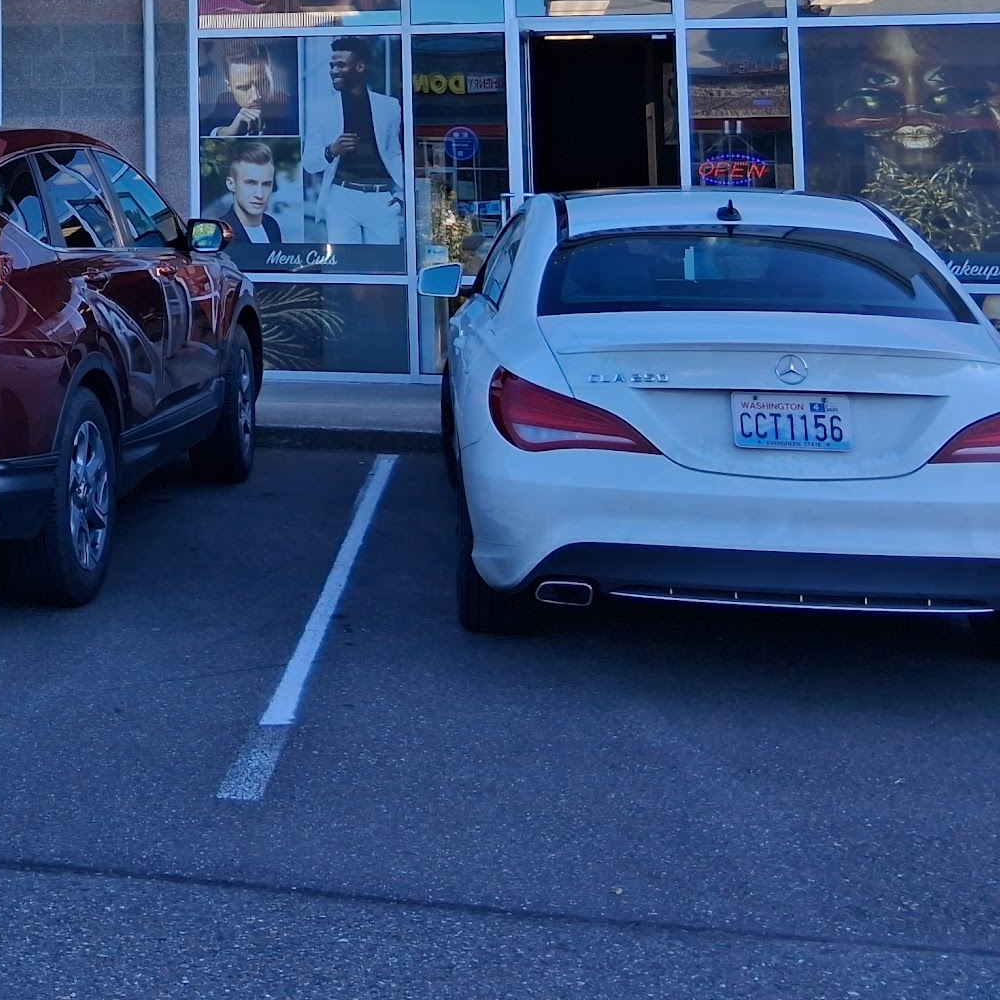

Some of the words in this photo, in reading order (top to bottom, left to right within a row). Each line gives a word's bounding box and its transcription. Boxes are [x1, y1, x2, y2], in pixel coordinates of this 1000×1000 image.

[698, 161, 766, 178] OPEN
[266, 250, 302, 266] Mens
[305, 249, 337, 266] Cuts
[588, 374, 626, 383] CLA
[740, 402, 804, 411] WASHINGTON
[740, 412, 844, 442] CCT1156
